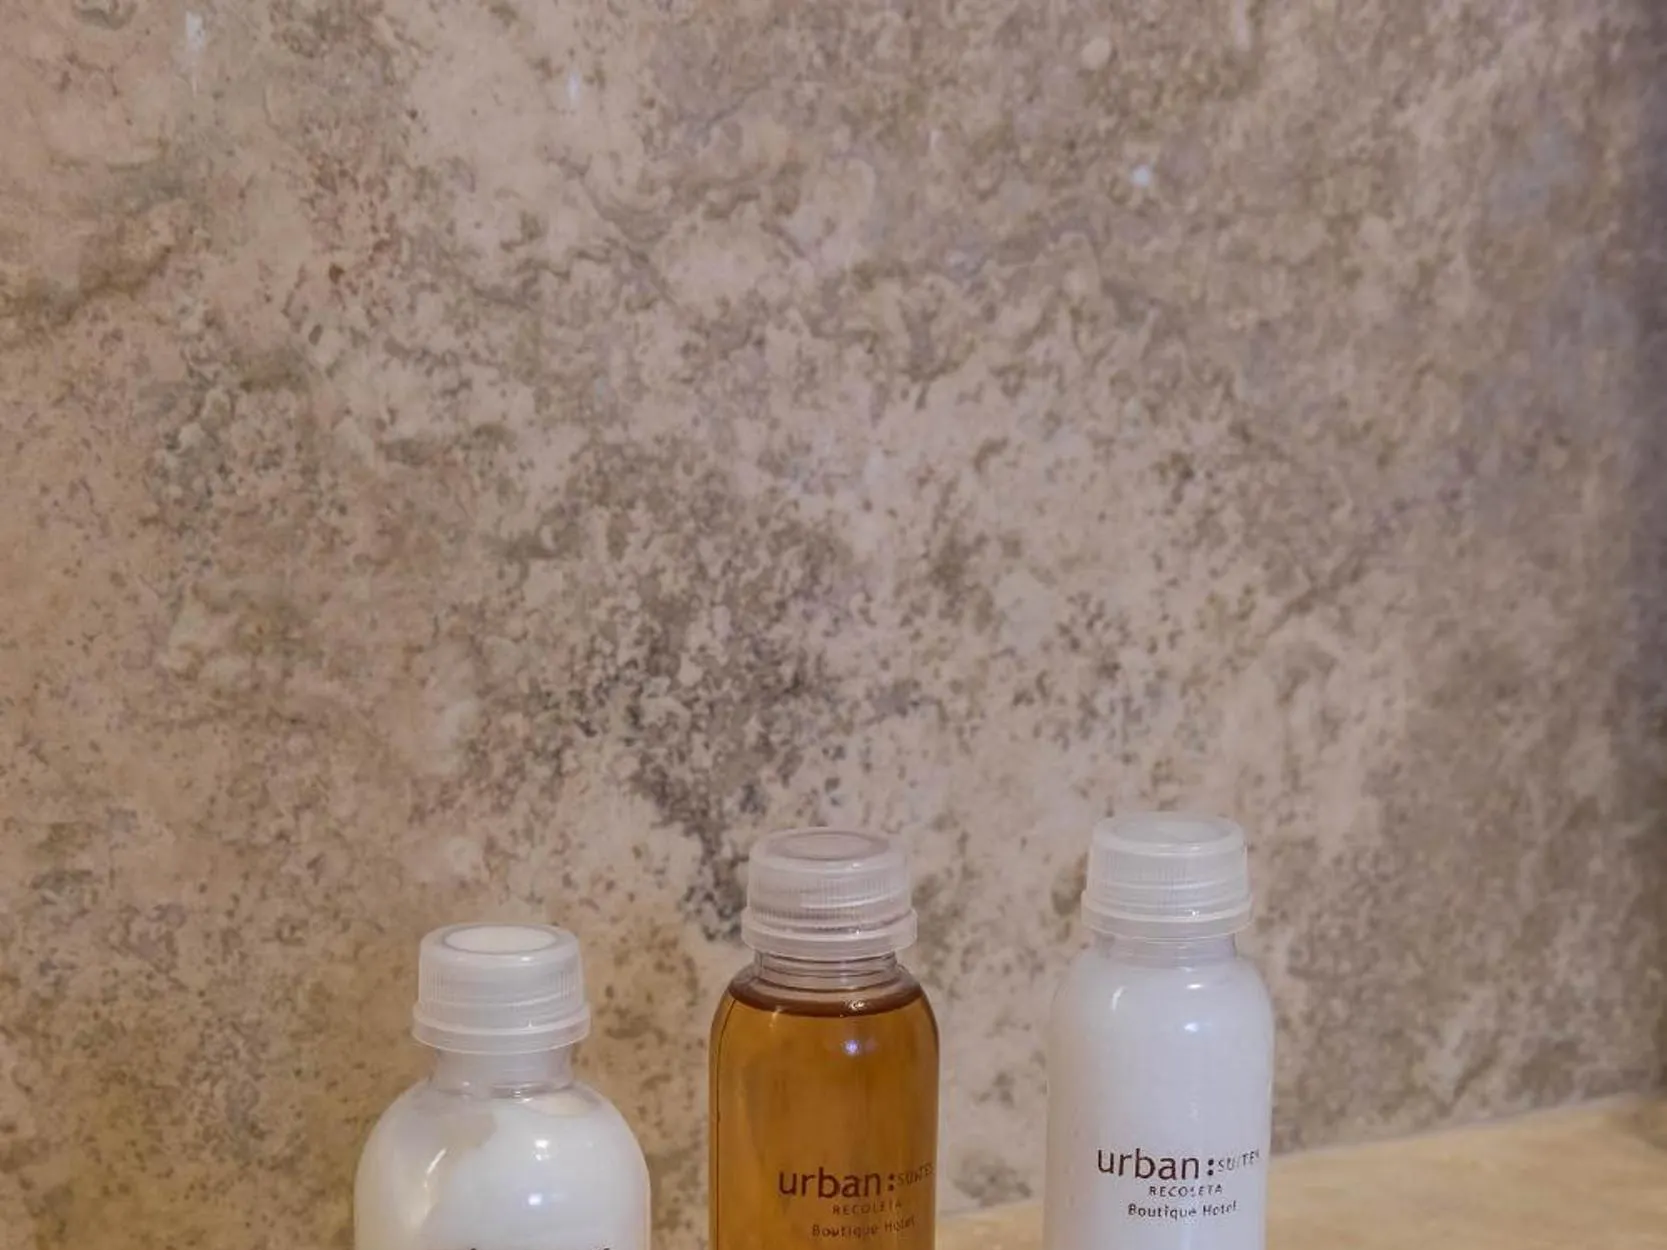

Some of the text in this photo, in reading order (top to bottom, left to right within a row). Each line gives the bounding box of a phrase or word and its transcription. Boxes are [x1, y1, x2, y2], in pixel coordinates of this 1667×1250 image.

[1128, 1200, 1237, 1221] Boutique Hotel
[811, 1223, 878, 1240] Boutique
